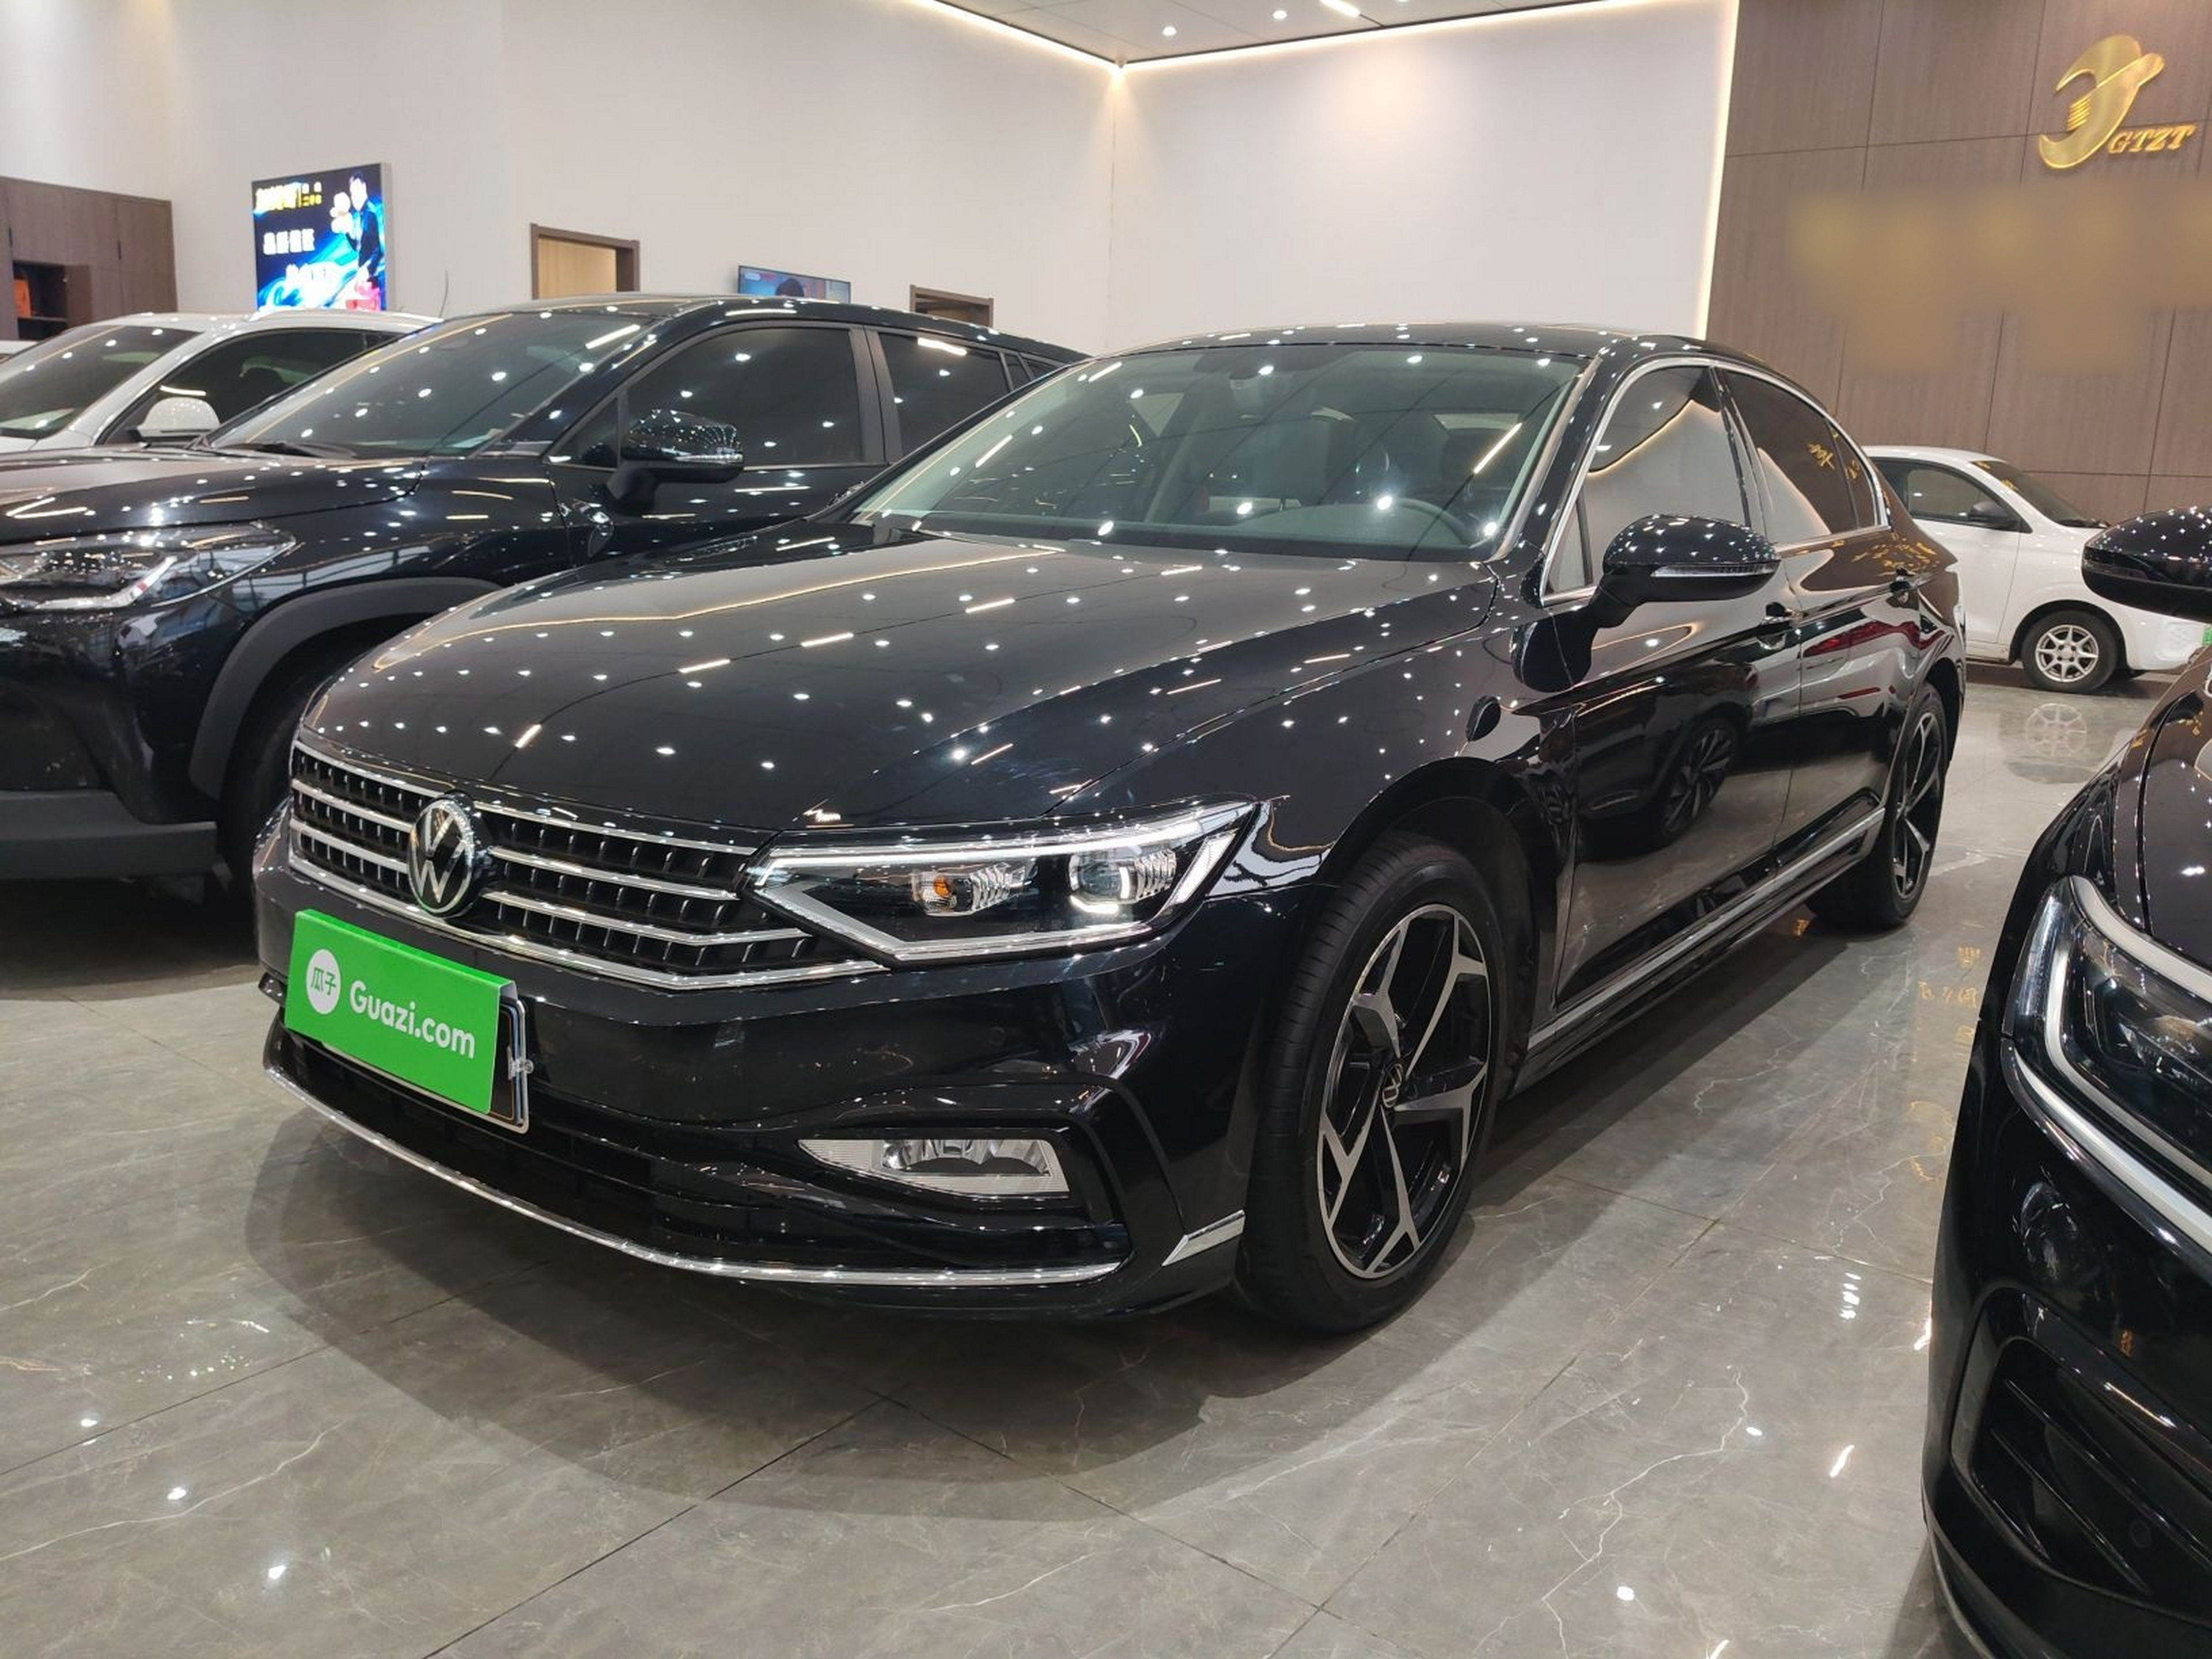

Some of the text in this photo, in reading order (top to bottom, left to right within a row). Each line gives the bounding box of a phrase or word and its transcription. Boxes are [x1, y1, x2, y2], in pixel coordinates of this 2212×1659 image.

[2108, 124, 2196, 154] GTZT
[310, 967, 337, 996] 瓜子
[350, 980, 475, 1059] Guazi.com
